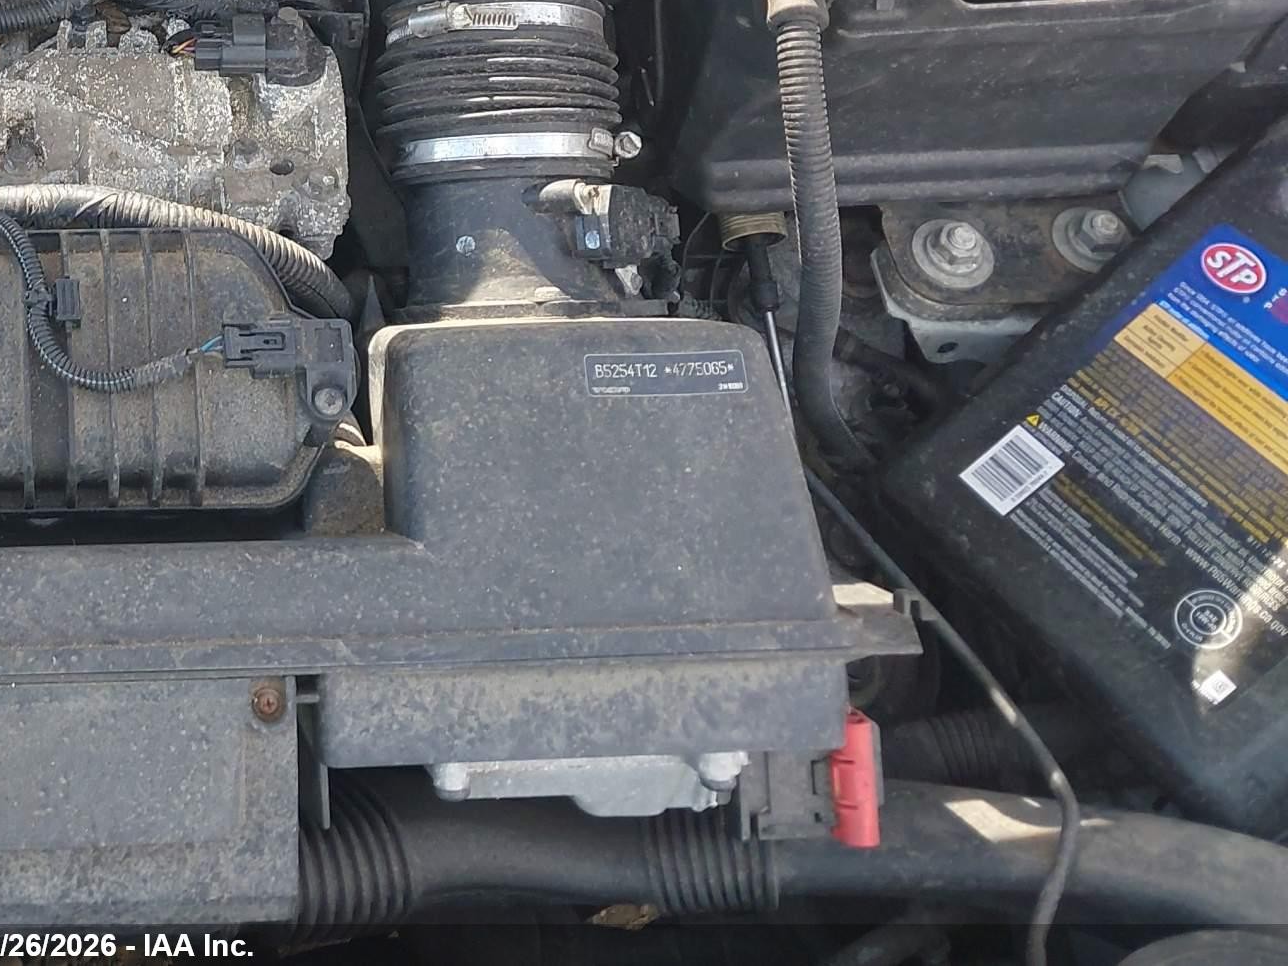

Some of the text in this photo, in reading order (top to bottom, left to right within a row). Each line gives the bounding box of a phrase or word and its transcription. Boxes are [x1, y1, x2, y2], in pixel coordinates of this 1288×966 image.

[1206, 250, 1258, 284] STP
[594, 363, 658, 379] B5254T12
[1095, 471, 1116, 488] and
[1156, 523, 1183, 546] Harm
